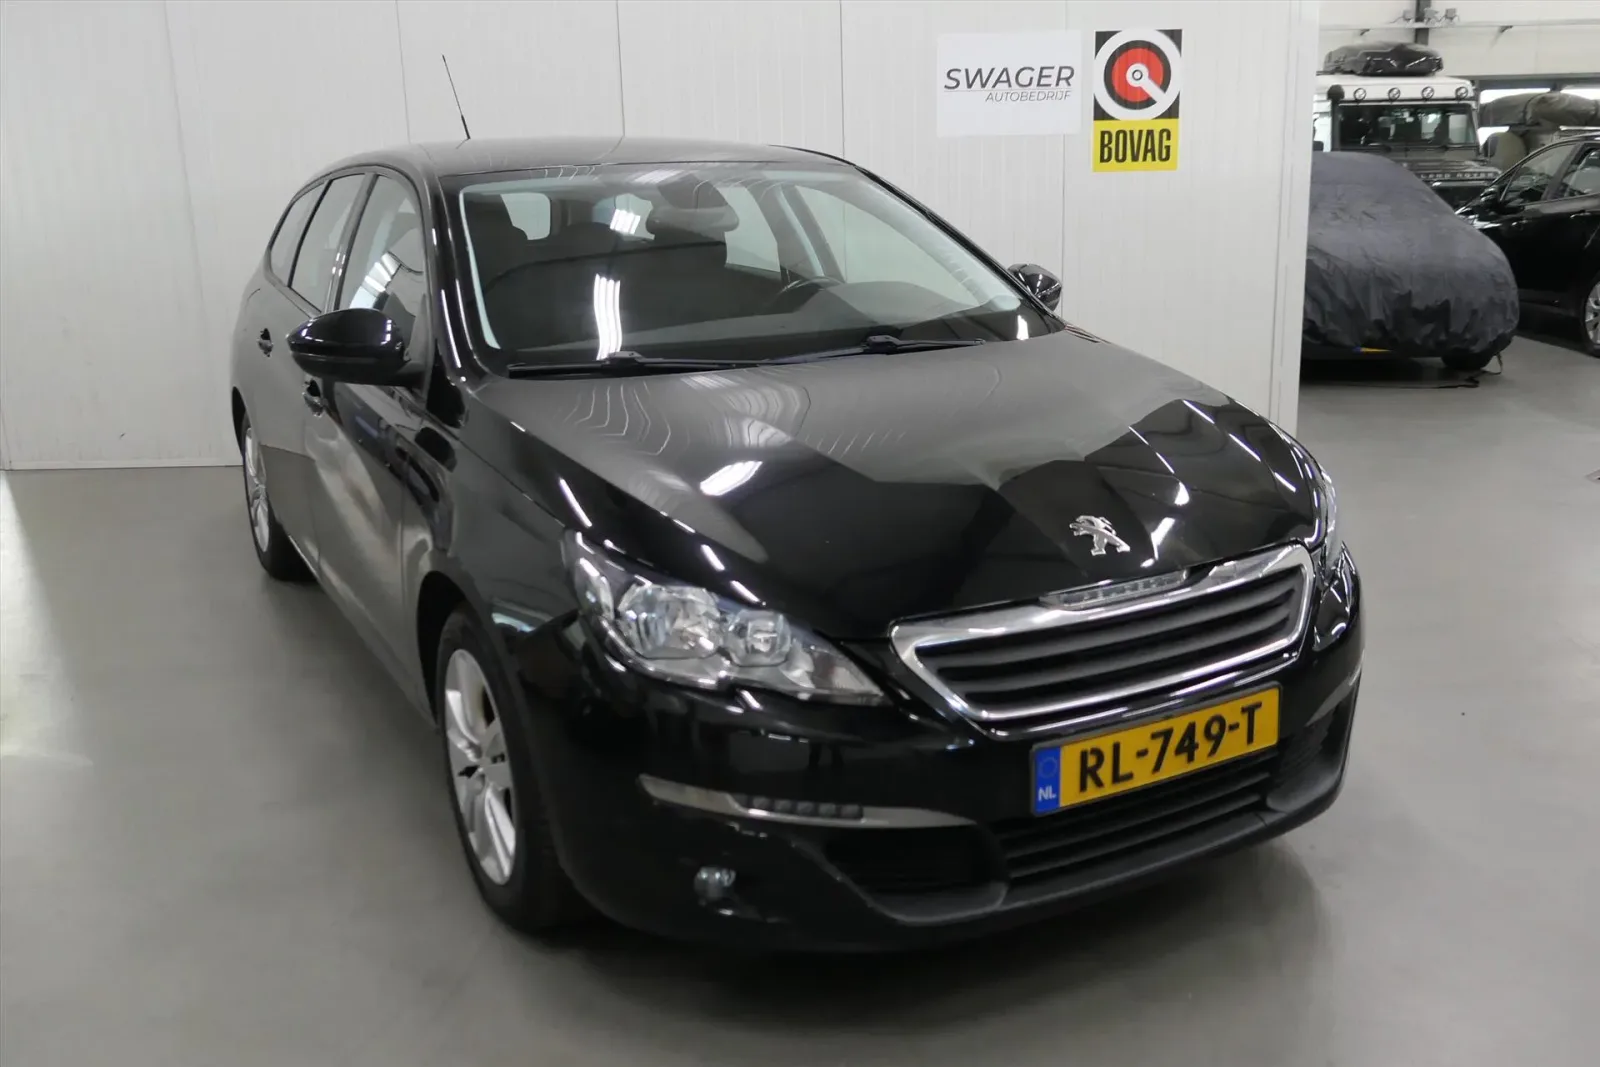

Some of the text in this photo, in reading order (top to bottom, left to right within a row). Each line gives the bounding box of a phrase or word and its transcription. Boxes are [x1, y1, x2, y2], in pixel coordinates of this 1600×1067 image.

[944, 65, 1075, 90] SWAGER
[985, 90, 1072, 103] AUTOBEDRIJF
[1099, 128, 1171, 164] BOVAG
[1079, 701, 1263, 793] RL-749-T
[1038, 785, 1056, 801] NL
